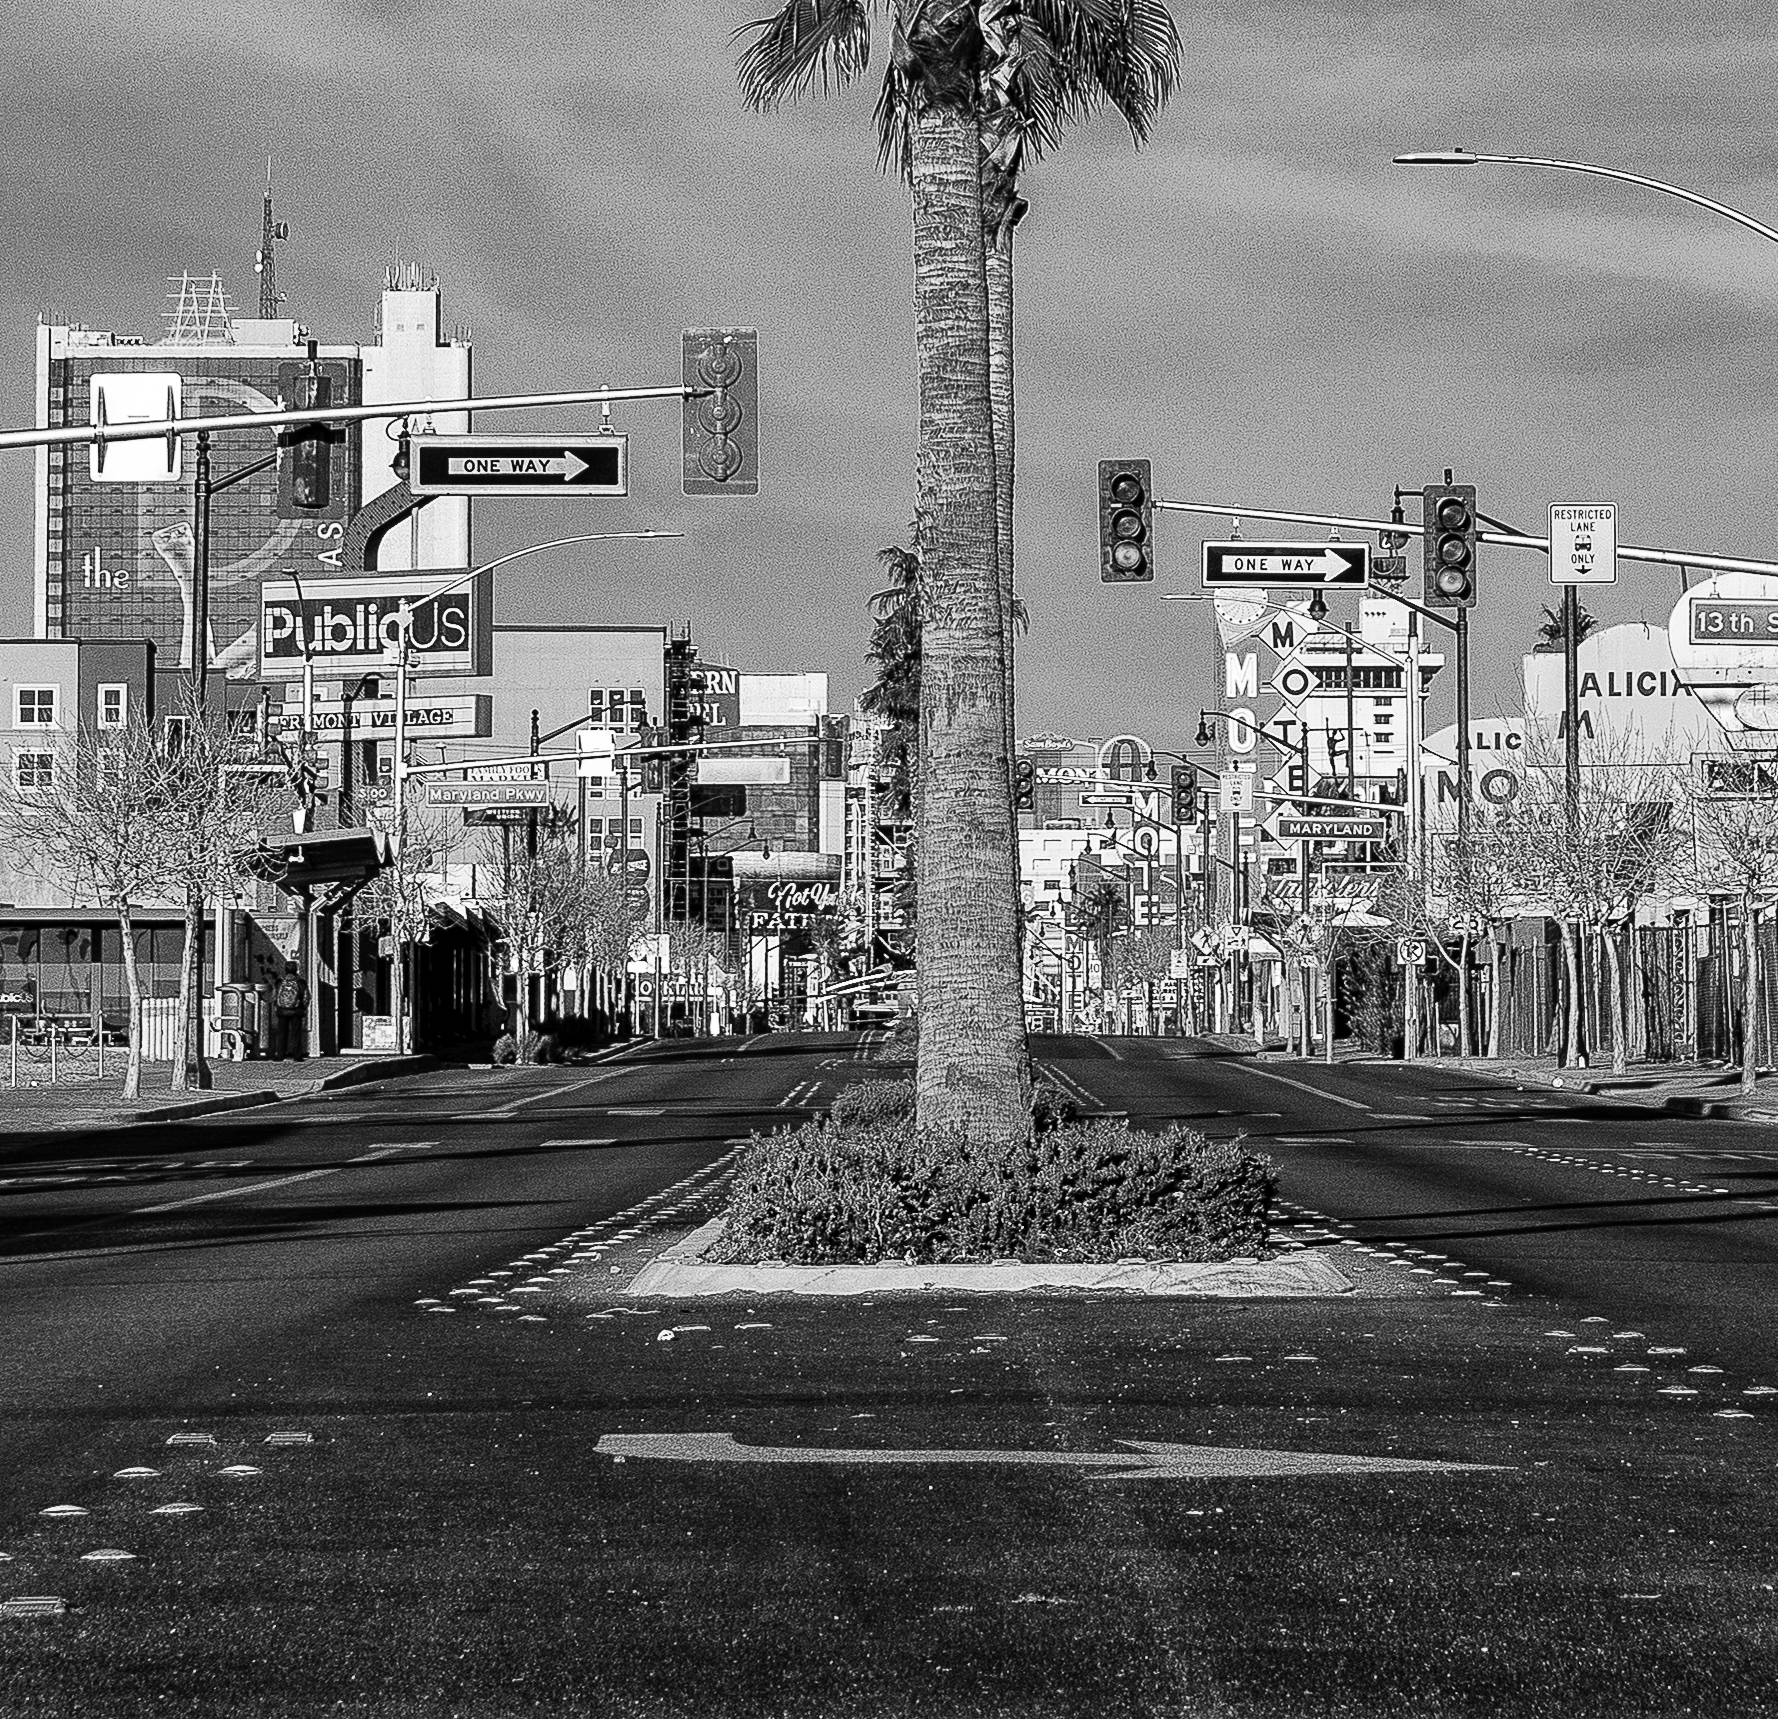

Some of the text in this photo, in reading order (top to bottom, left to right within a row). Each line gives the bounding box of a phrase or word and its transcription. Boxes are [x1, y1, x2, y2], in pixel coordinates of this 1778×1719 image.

[462, 457, 551, 475] ONE WAY
[1554, 509, 1612, 520] RESTRICTED
[1570, 522, 1595, 532] LANE
[1233, 558, 1315, 572] ONE WAY
[1570, 554, 1595, 564] ONLY
[82, 546, 130, 589] the
[1697, 611, 1753, 634] 13th
[276, 709, 453, 729] FRMONT VILAGE
[1273, 622, 1309, 817] MOTE
[429, 787, 545, 803] Maryland Pkwy
[1289, 822, 1373, 835] MARYLAND
